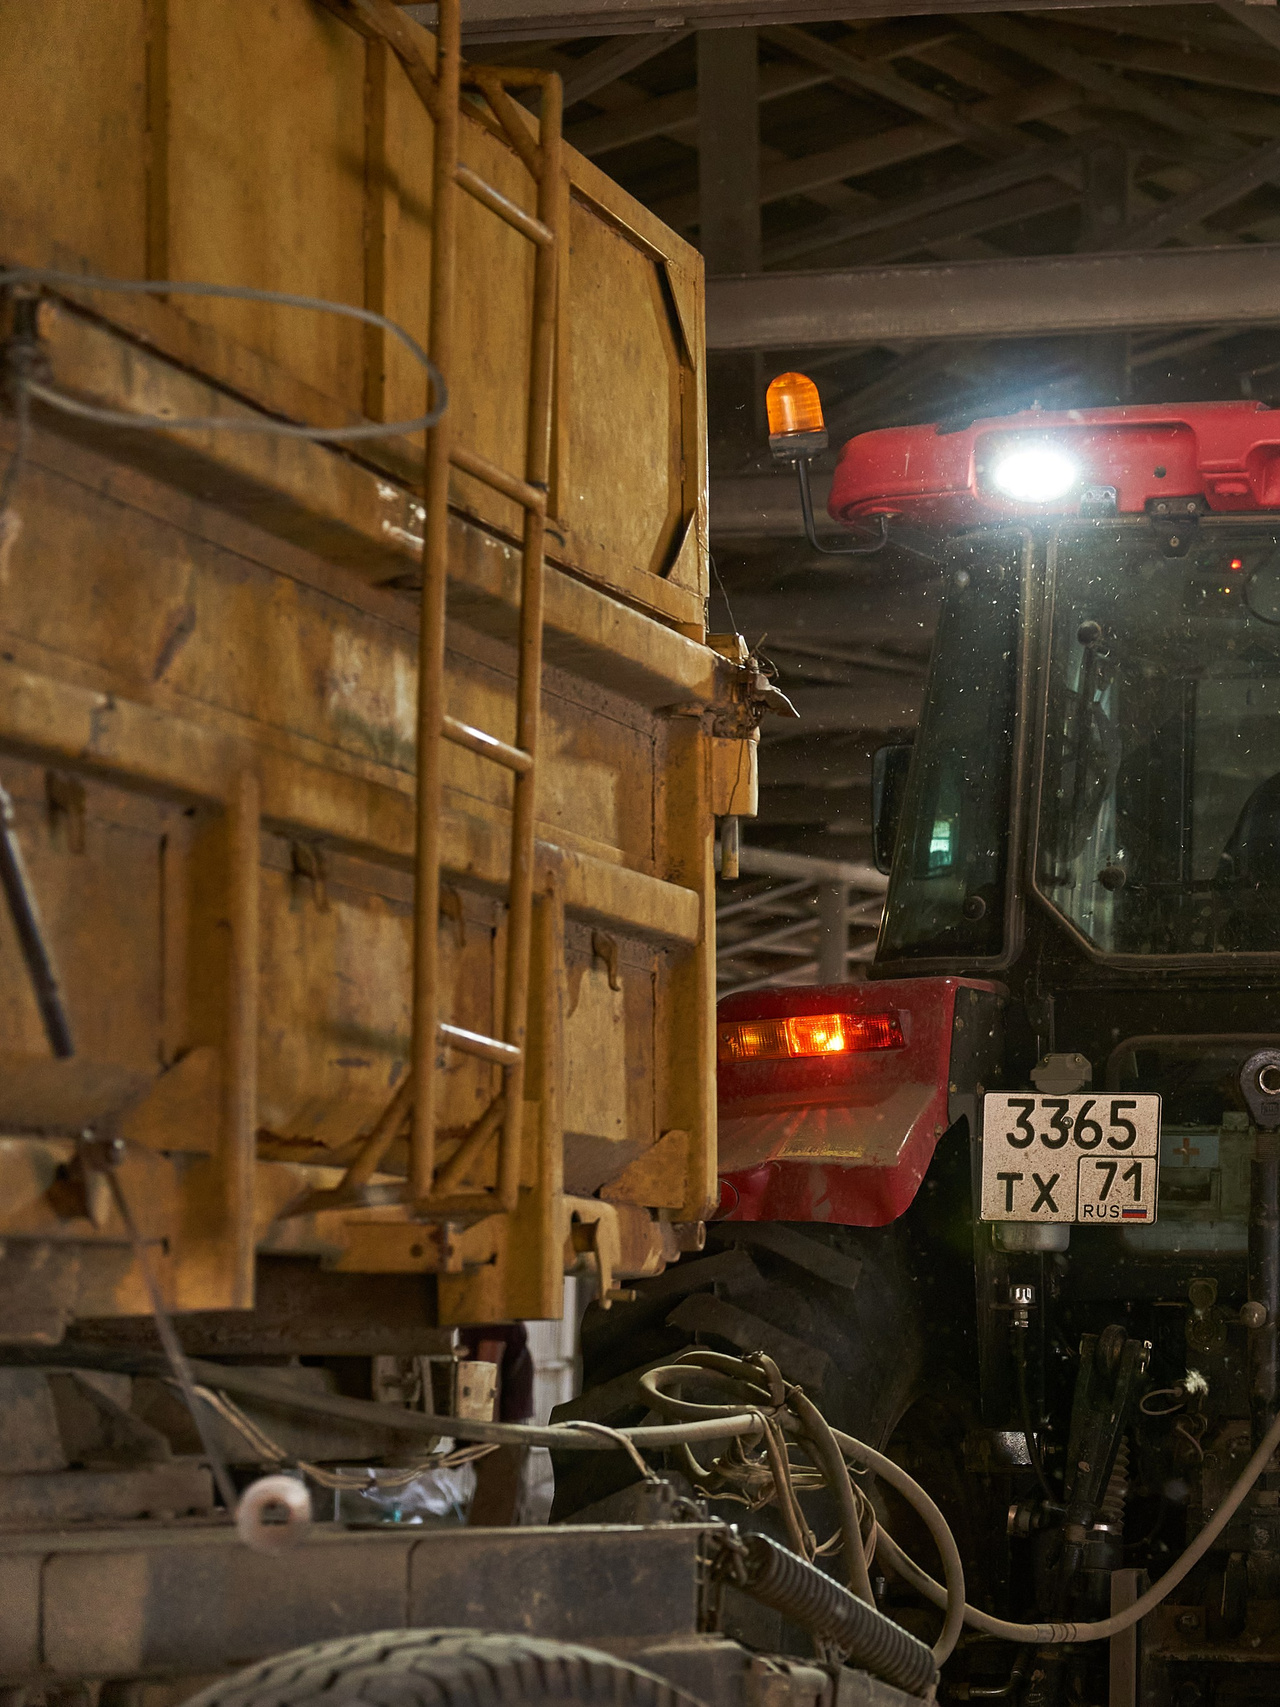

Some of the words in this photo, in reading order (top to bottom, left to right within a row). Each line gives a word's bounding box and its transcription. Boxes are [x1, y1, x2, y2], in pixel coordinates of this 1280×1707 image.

[1006, 1098, 1137, 1150] 3365
[1095, 1161, 1142, 1202] 71
[1083, 1205, 1120, 1218] RUS
